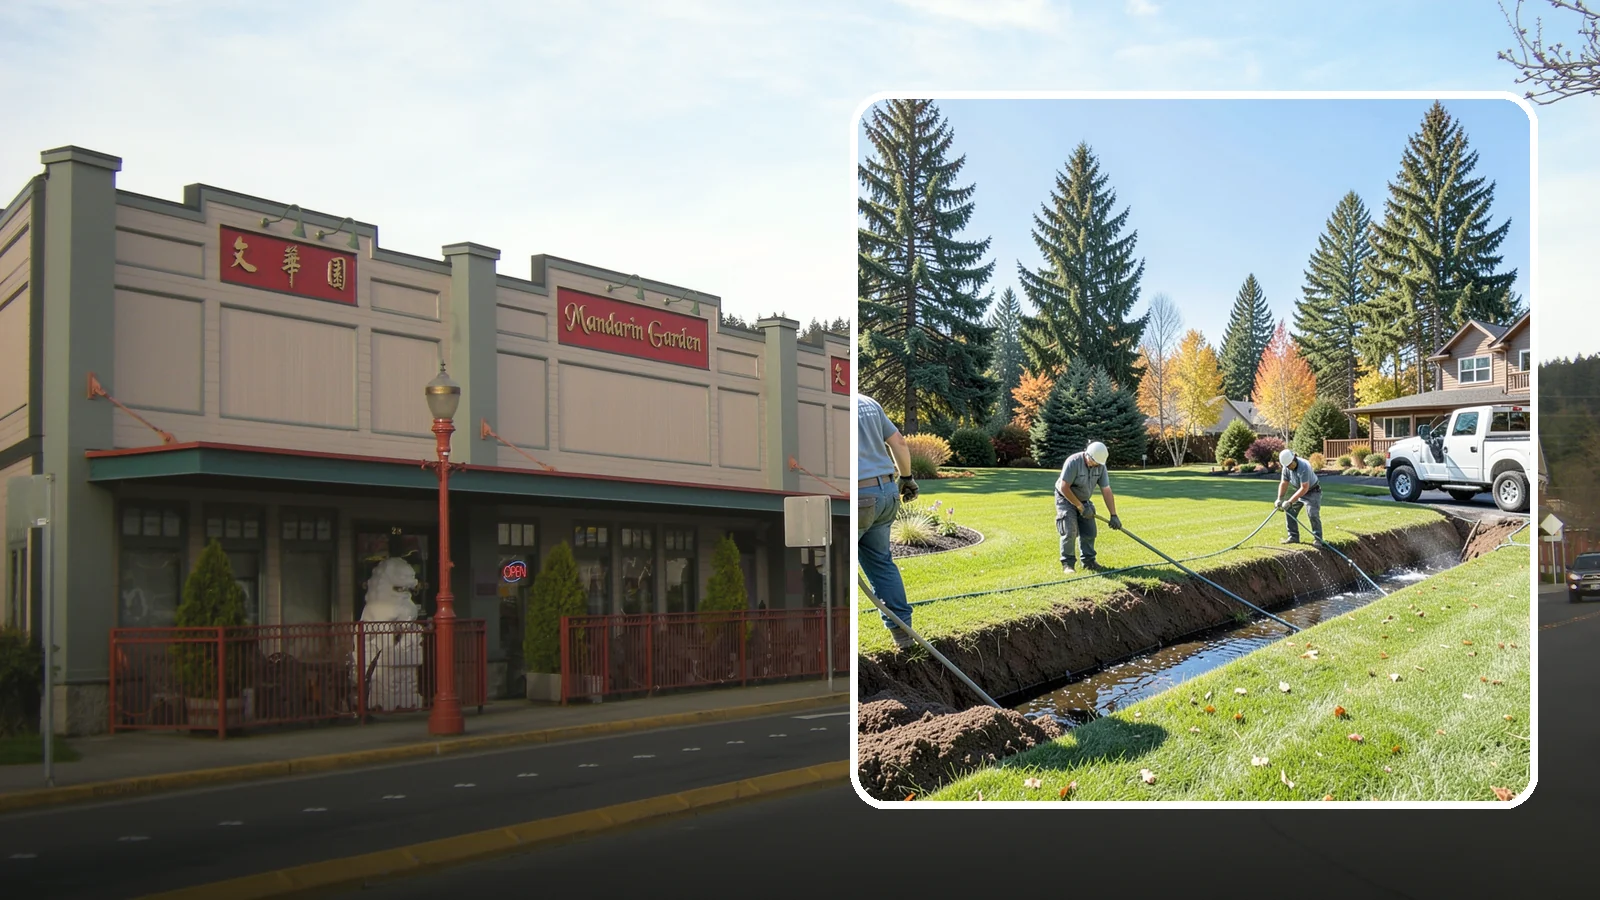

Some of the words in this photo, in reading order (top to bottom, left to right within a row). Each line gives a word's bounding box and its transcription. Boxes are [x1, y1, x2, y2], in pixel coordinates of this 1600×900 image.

[564, 302, 644, 340] Mandarin
[648, 321, 701, 352] Garden
[503, 565, 526, 578] OPEN
